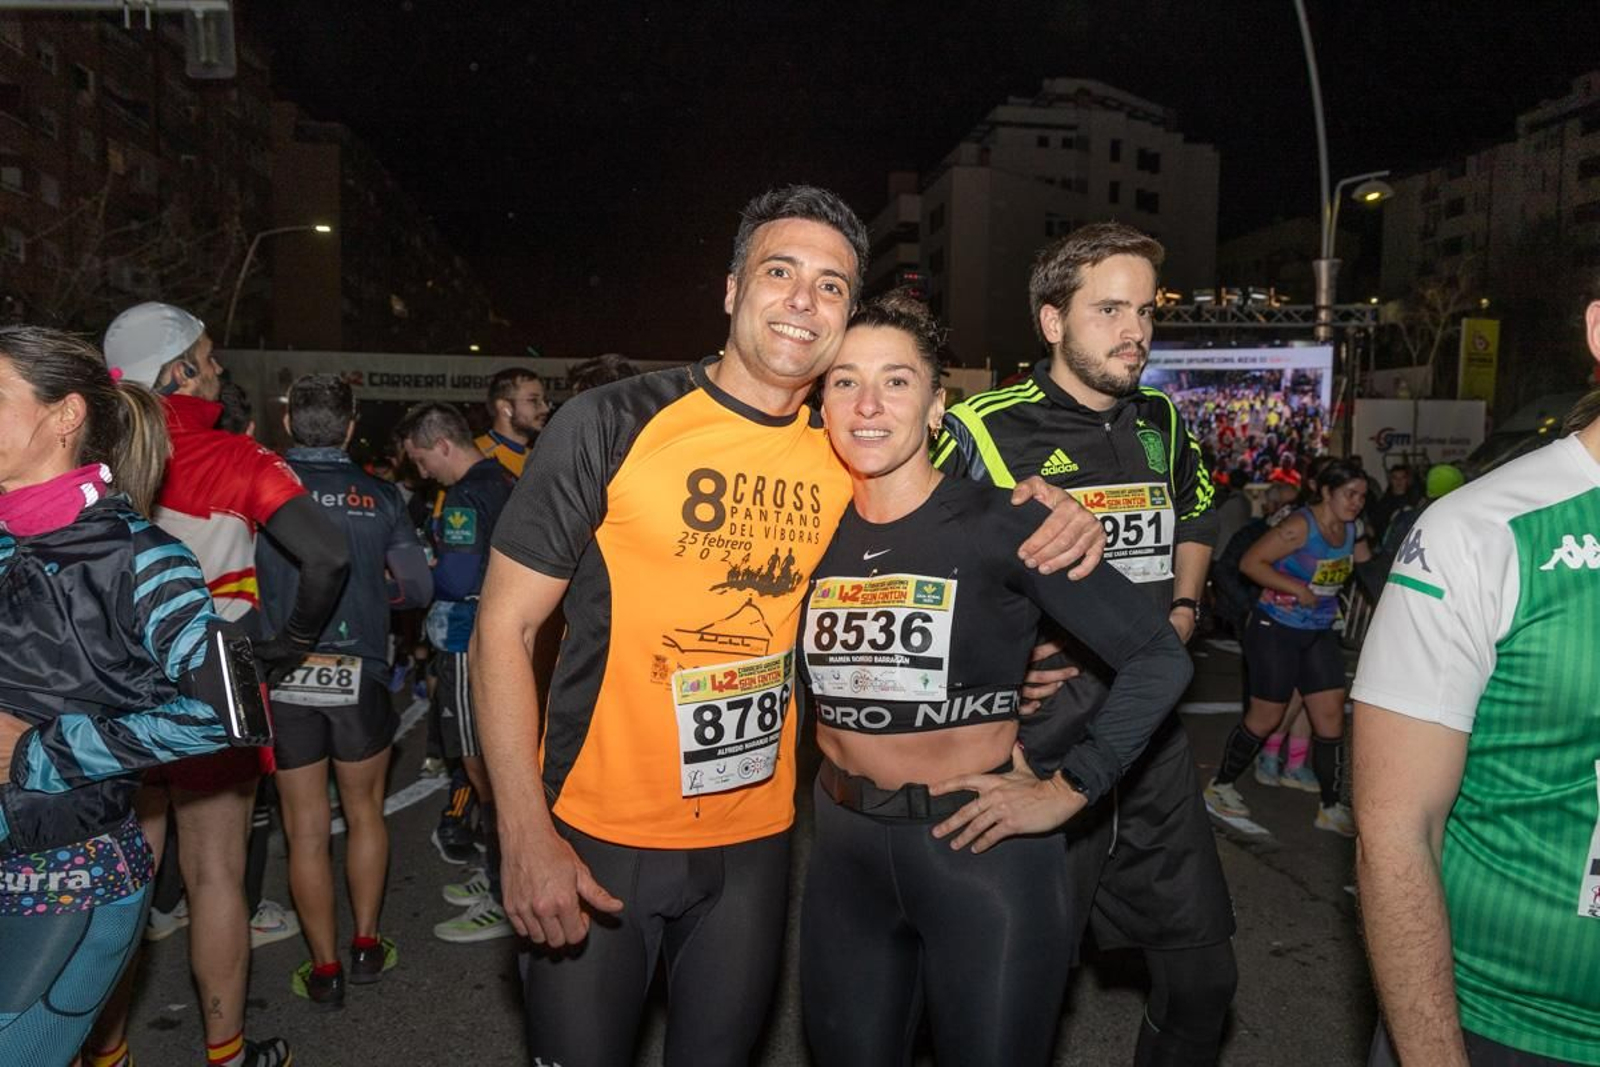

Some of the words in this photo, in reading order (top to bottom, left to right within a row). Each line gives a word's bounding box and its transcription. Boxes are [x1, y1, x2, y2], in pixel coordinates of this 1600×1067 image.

[368, 372, 447, 388] CARRERA
[1041, 463, 1079, 476] adidas
[682, 467, 727, 532] 8
[732, 472, 821, 514] CROSS
[1083, 492, 1106, 508] 42
[730, 506, 820, 529] PANTANO
[677, 531, 699, 545] 25
[702, 533, 753, 551] febrero
[729, 523, 754, 537] DEL
[764, 525, 820, 545] VÍBORAS
[1099, 511, 1162, 549] 951
[838, 583, 863, 603] 42
[814, 610, 934, 654] 8536
[710, 670, 739, 692] 42
[820, 703, 892, 729] PRO
[914, 690, 1014, 727] NIKE
[0, 870, 91, 892] urra
